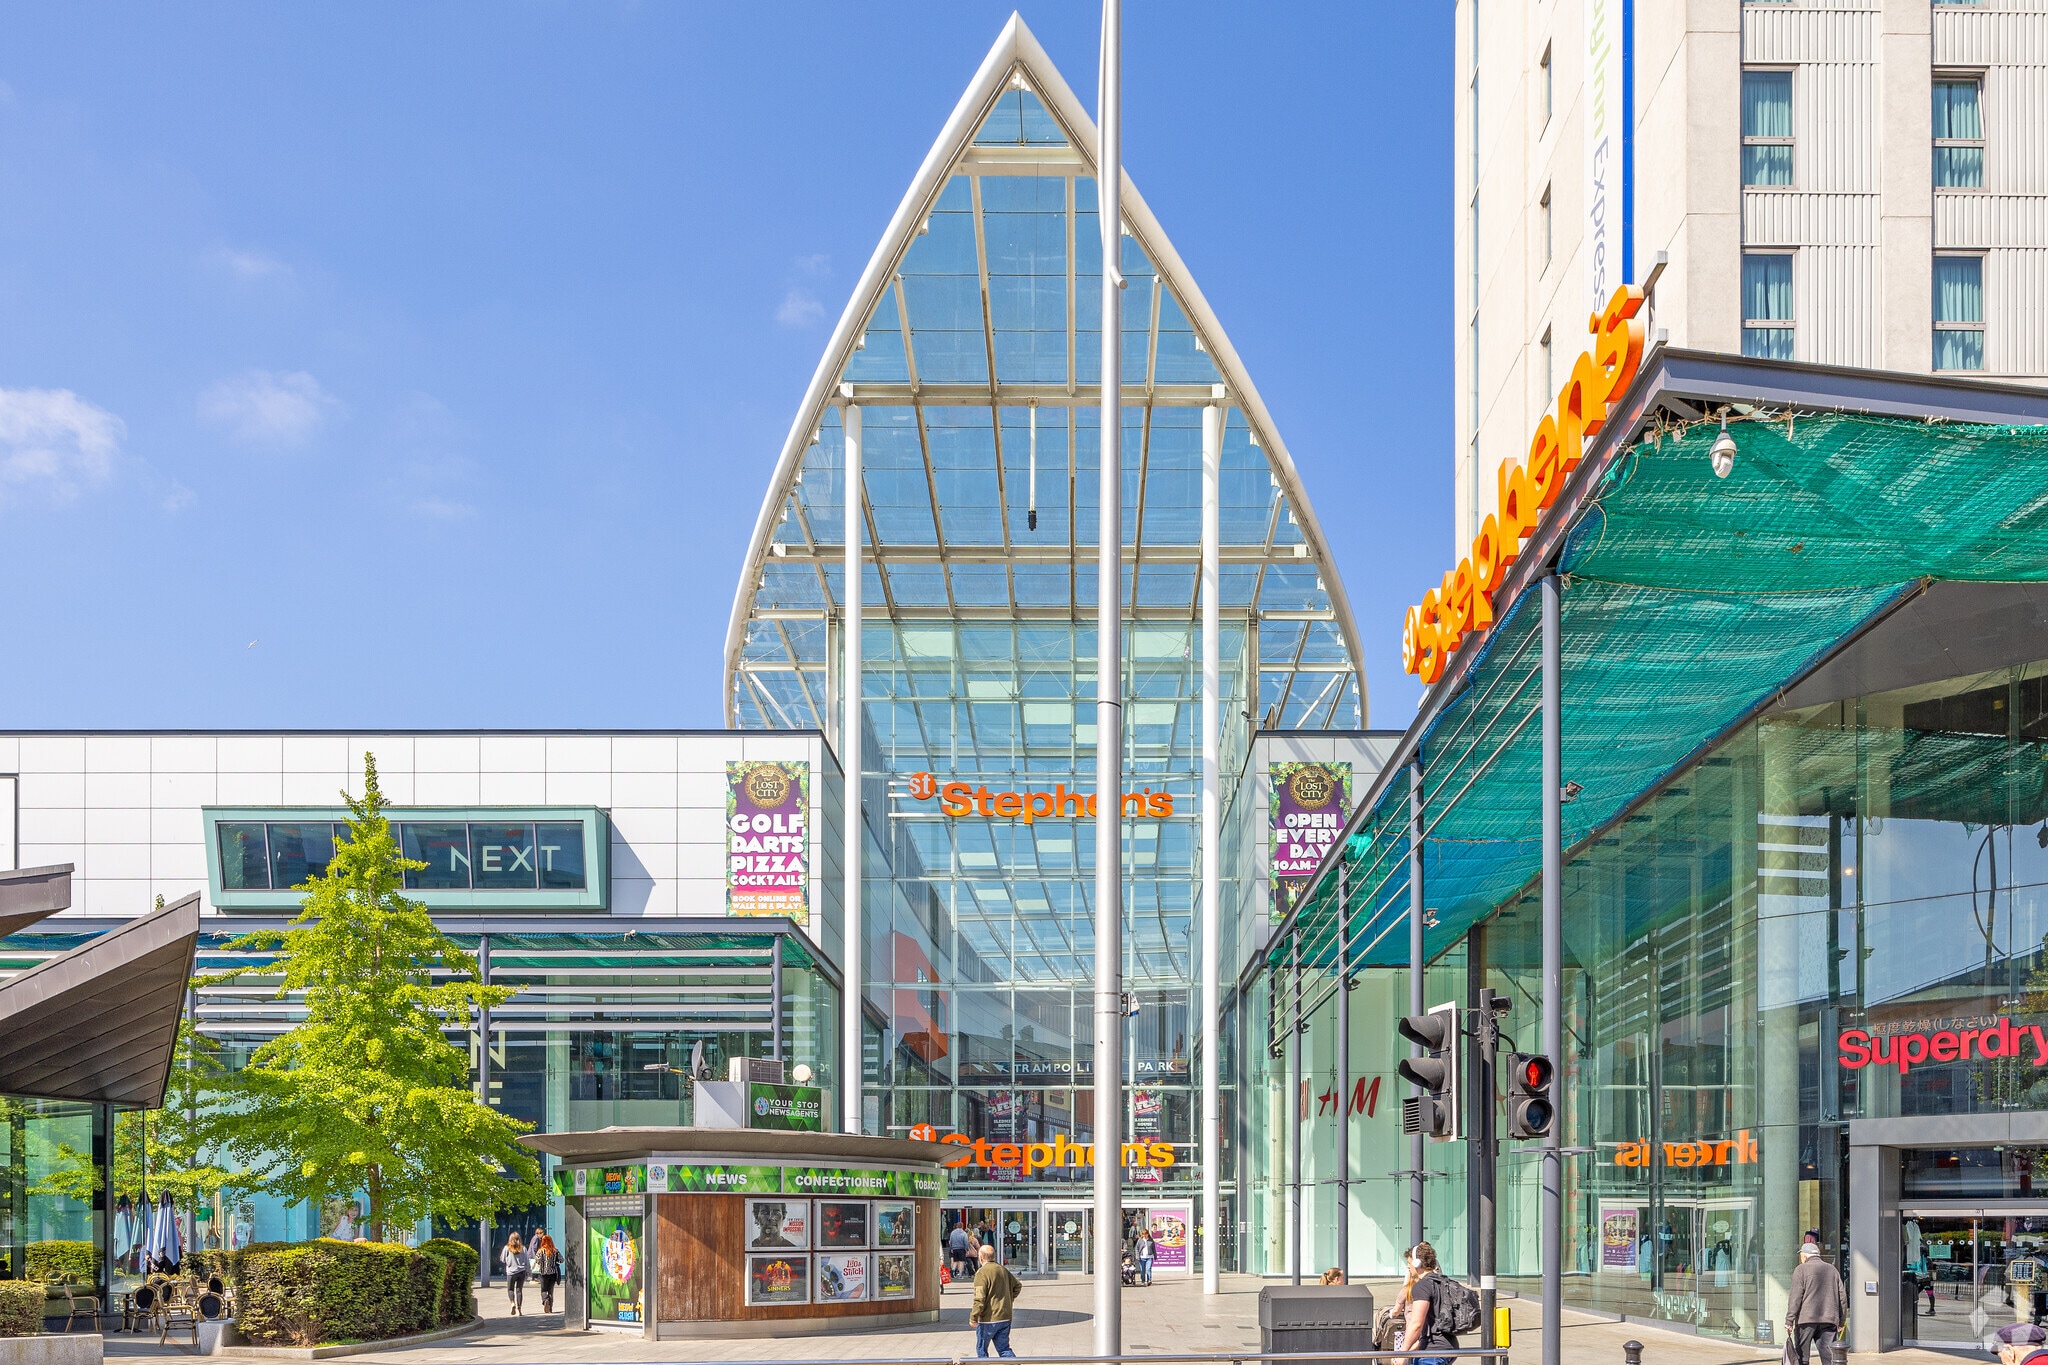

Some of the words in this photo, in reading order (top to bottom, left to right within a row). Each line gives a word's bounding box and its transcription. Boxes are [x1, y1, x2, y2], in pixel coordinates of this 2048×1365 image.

[1590, 135, 1609, 311] Express
[1419, 284, 1644, 684] Stephen's
[756, 781, 779, 789] LOST
[908, 773, 931, 795] st
[1300, 782, 1322, 791] LOST
[756, 789, 778, 797] CITY
[1300, 790, 1322, 798] CITY
[730, 813, 804, 834] GOLF
[1284, 813, 1337, 828] OPEN
[1276, 829, 1344, 843] EVERY
[731, 835, 804, 853] DARTS
[450, 845, 561, 872] NEXT
[730, 855, 806, 873] PIZZA
[730, 874, 806, 886] COCKTAILS
[1838, 1017, 2048, 1074] Superdry
[1138, 1061, 1175, 1072] PARK
[770, 1098, 793, 1107] YOUR
[769, 1108, 819, 1118] NEWSAGENTS
[705, 1173, 747, 1185] NEWS
[795, 1175, 888, 1189] CONFECTIONERY
[914, 1179, 941, 1190] TOBACCO
[843, 1266, 864, 1277] STITCH
